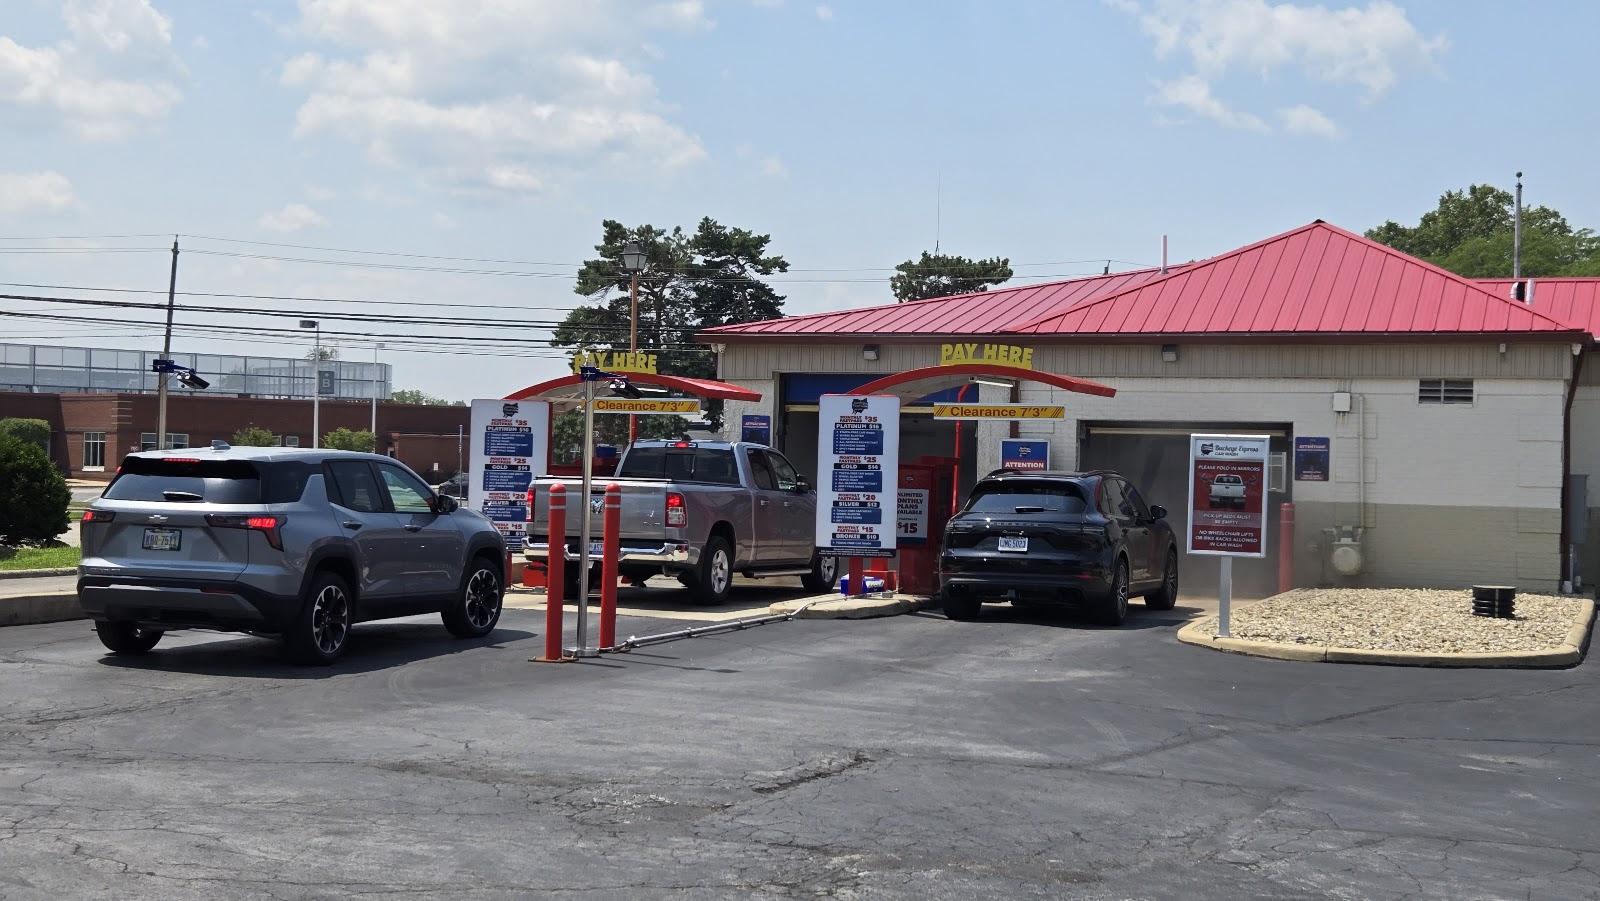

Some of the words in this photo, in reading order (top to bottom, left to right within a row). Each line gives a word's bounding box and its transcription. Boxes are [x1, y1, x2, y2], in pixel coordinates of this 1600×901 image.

[942, 343, 978, 363] PAY
[982, 344, 1034, 368] HERE
[573, 351, 607, 373] PAY
[612, 352, 657, 374] HERE
[596, 400, 656, 411] Clearance
[950, 406, 1016, 417] Clearance
[898, 522, 918, 534] $15
